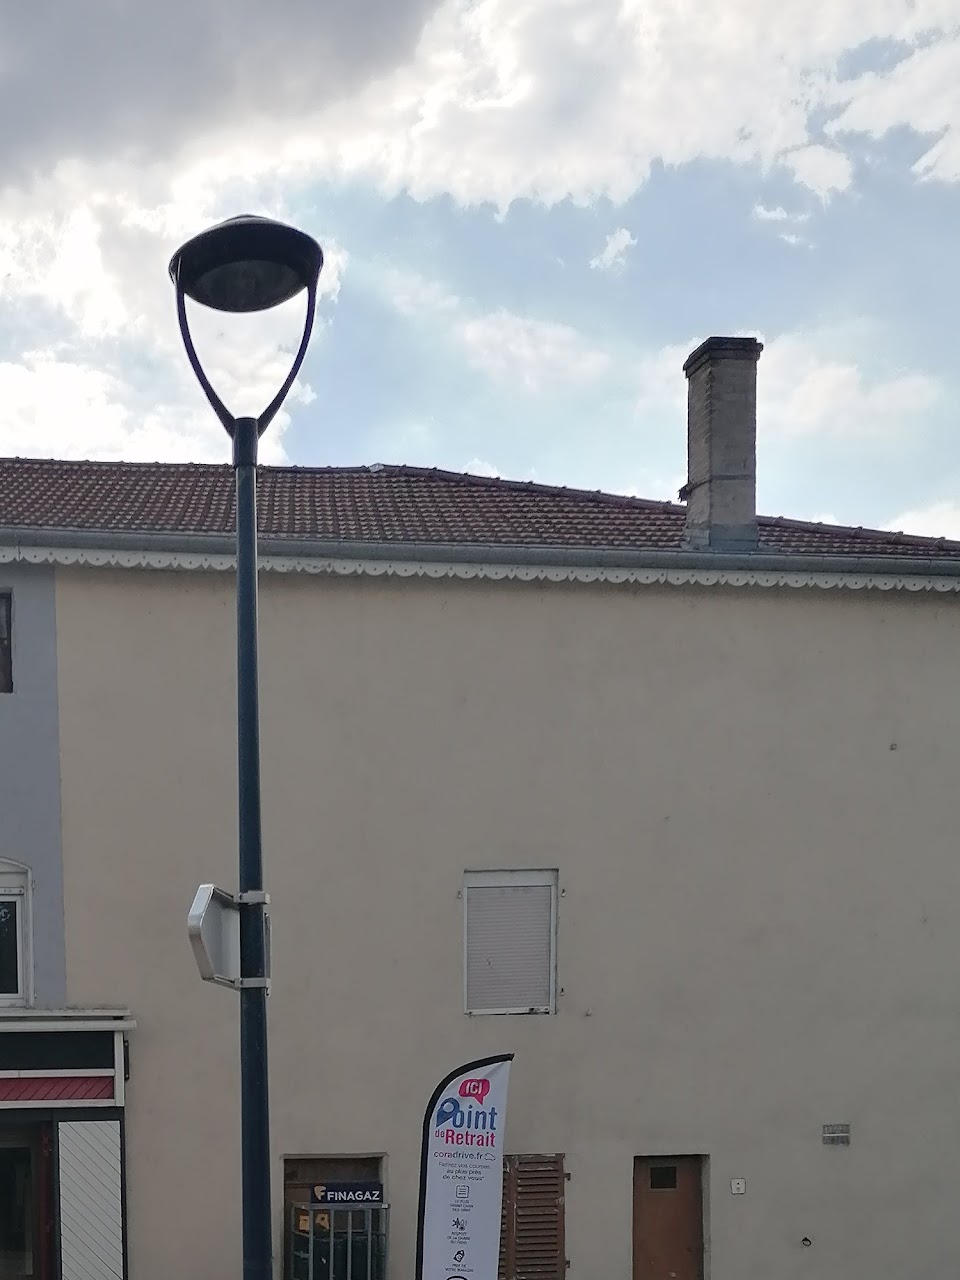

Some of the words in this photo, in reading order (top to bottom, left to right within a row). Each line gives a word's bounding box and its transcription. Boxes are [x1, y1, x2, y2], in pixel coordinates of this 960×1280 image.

[465, 1081, 483, 1094] ICI
[436, 1097, 498, 1131] Point
[435, 1129, 445, 1138] de
[445, 1129, 496, 1147] Retrait
[433, 1150, 483, 1160] coradrive.fr
[327, 1191, 380, 1201] FINAGAZ
